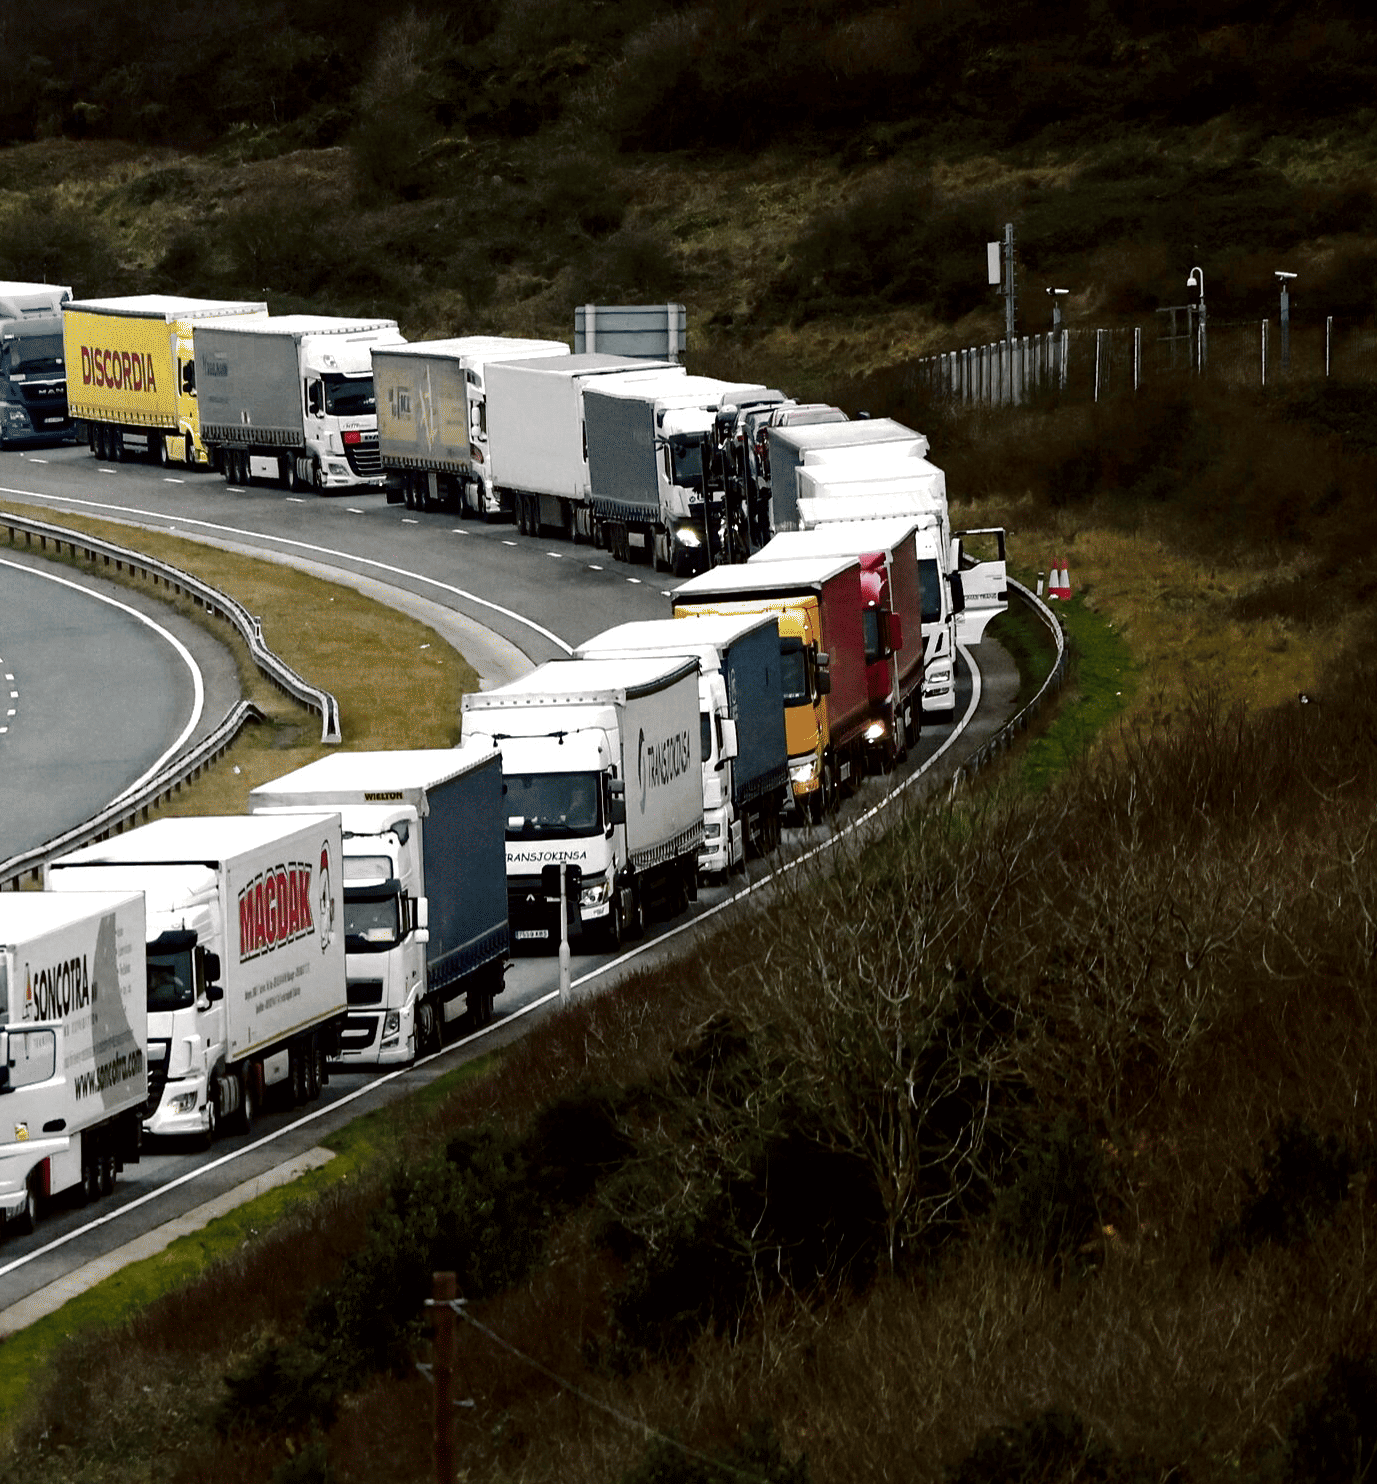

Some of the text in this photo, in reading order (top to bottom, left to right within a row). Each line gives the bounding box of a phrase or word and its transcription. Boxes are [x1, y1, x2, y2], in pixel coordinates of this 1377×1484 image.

[80, 346, 157, 393] DISCORDIA
[647, 727, 691, 790] TRANSJOKINSA
[364, 791, 403, 801] WIELTON
[506, 851, 587, 863] RANSJOKINSA
[238, 861, 315, 964] MAGDAK
[33, 953, 90, 1022] SONCOTRA
